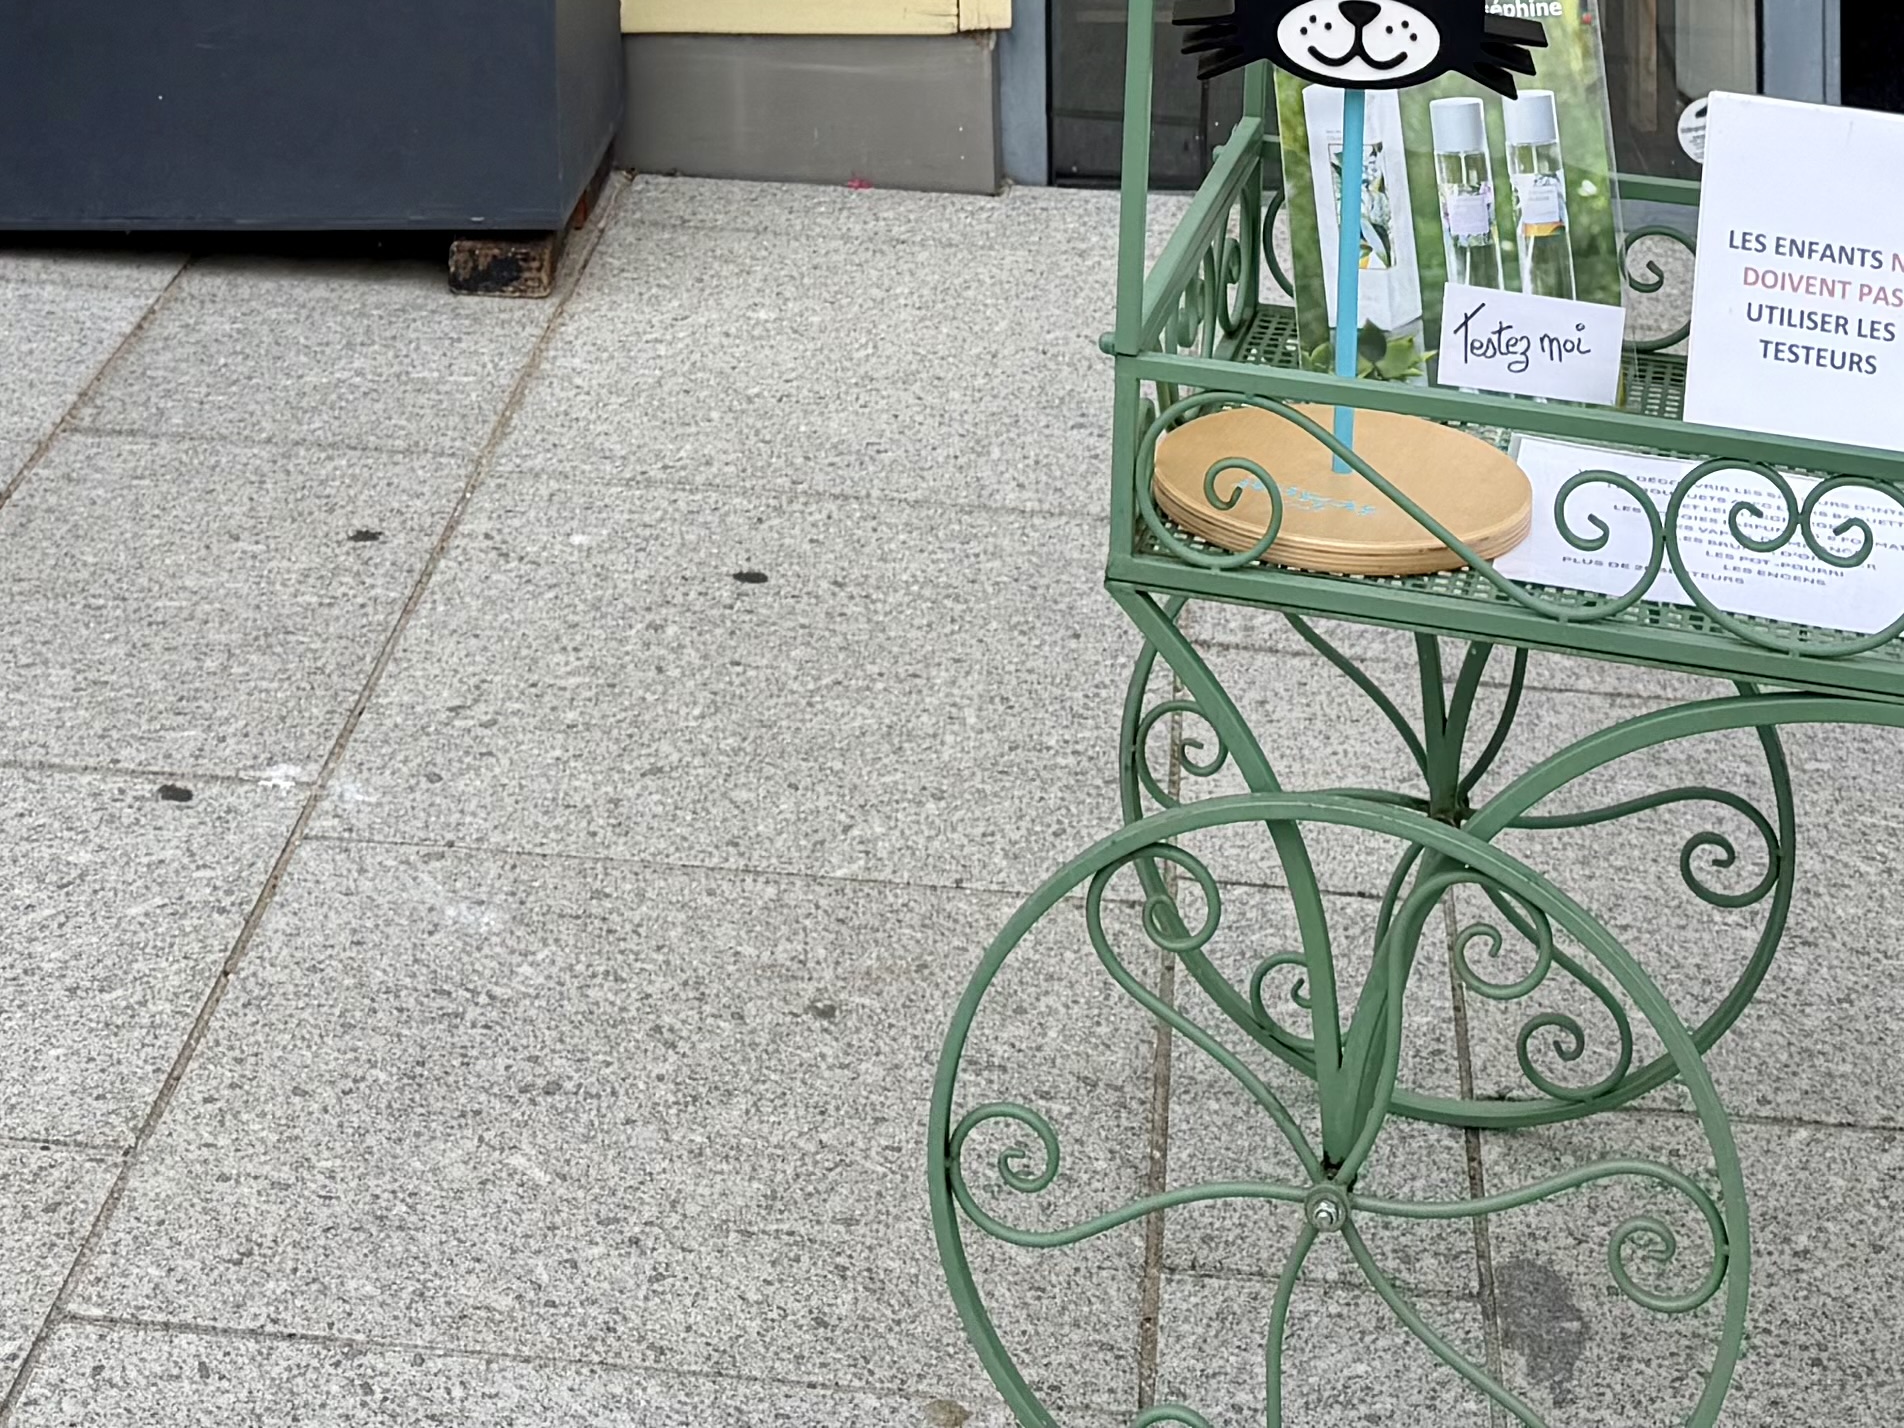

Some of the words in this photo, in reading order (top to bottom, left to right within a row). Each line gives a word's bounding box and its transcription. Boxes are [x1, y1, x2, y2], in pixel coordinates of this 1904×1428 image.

[1728, 229, 1768, 254] LES
[1774, 236, 1884, 271] ENFANTS
[1742, 265, 1852, 301] DOIVENT
[1858, 286, 1904, 308] PAS
[1453, 302, 1531, 373] Testez
[1539, 322, 1592, 362] moi
[1746, 301, 1850, 336] UTILISER
[1856, 317, 1896, 343] LES
[1759, 338, 1878, 375] TESTEURS
[1613, 503, 1642, 514] LES
[1562, 555, 1604, 567] PLUS
[1608, 561, 1631, 570] DE
[1705, 550, 1735, 561] LES
[1723, 564, 1753, 574] LES
